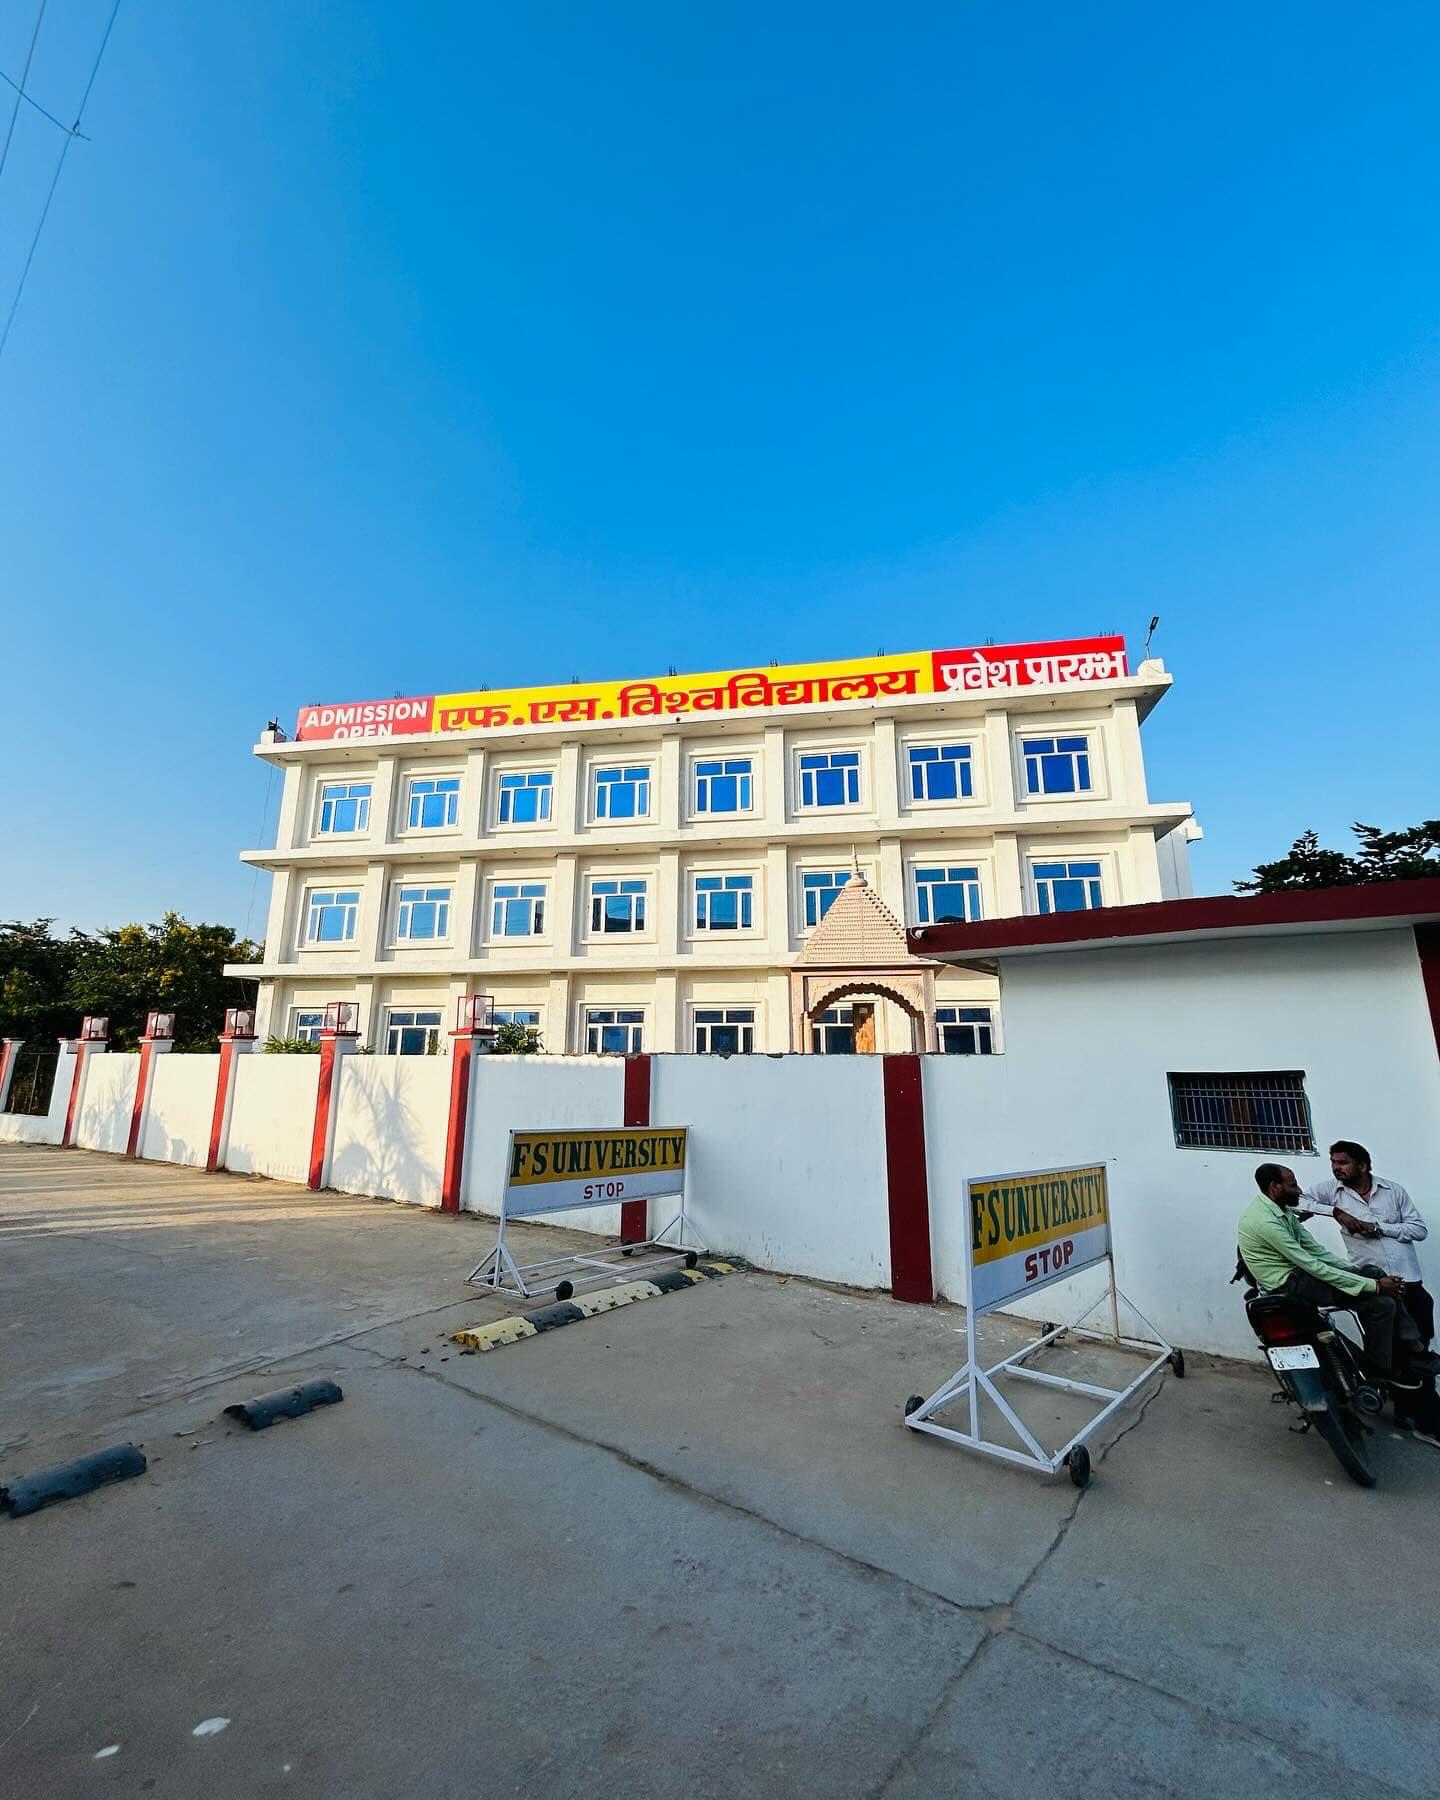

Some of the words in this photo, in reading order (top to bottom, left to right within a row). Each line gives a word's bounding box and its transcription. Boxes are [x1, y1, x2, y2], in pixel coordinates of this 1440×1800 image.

[940, 651, 1020, 691] प्रवेश
[1024, 651, 1126, 685] प्रारम्भ
[304, 701, 428, 728] ADMISSION
[333, 723, 394, 740] OPEN
[583, 1182, 625, 1200] STOP
[1024, 1239, 1074, 1282] STOP
